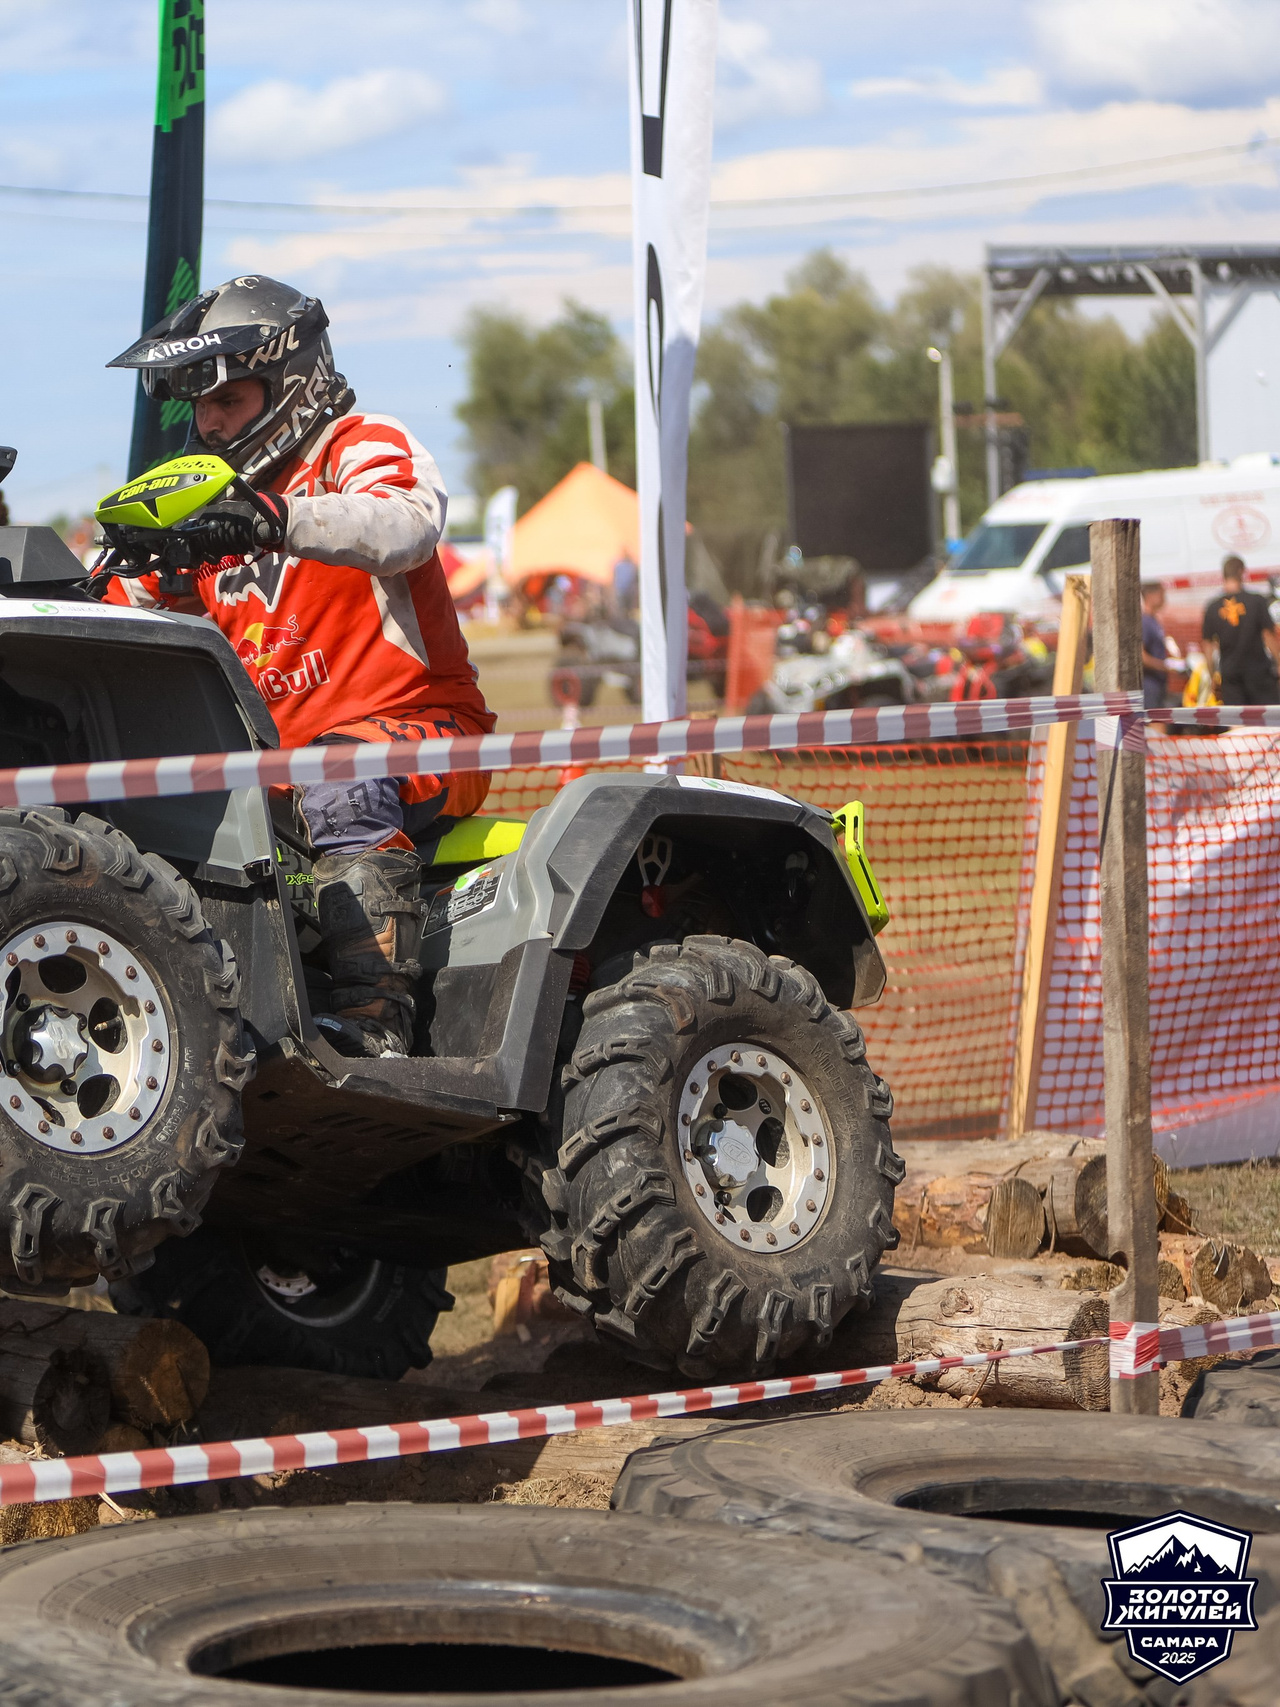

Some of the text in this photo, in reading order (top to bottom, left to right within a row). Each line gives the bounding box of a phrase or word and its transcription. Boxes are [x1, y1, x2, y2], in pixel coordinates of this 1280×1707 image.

[146, 333, 222, 361] AIROH
[117, 475, 180, 502] can-am
[263, 648, 330, 700] Bull
